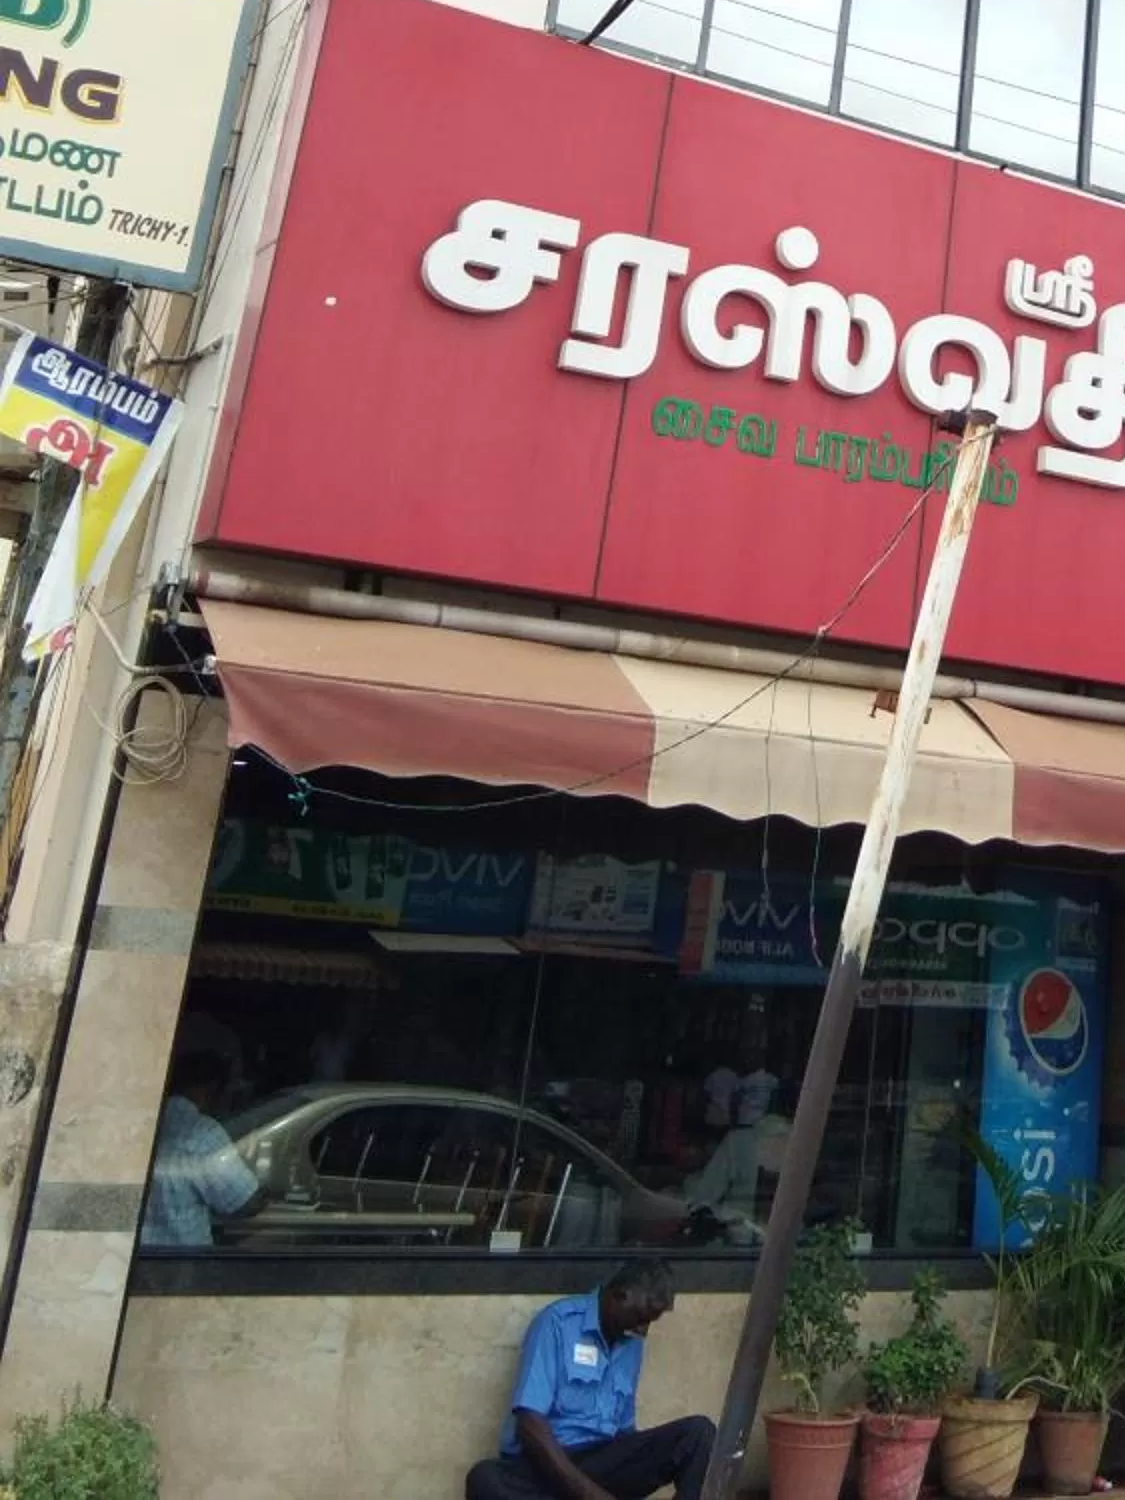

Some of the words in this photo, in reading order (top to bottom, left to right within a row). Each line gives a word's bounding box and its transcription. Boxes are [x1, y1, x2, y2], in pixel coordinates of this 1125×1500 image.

[1004, 255, 1097, 329] ஸ்ரீ
[31, 346, 161, 426] ஆரம்பம்
[652, 396, 777, 460] சைவ
